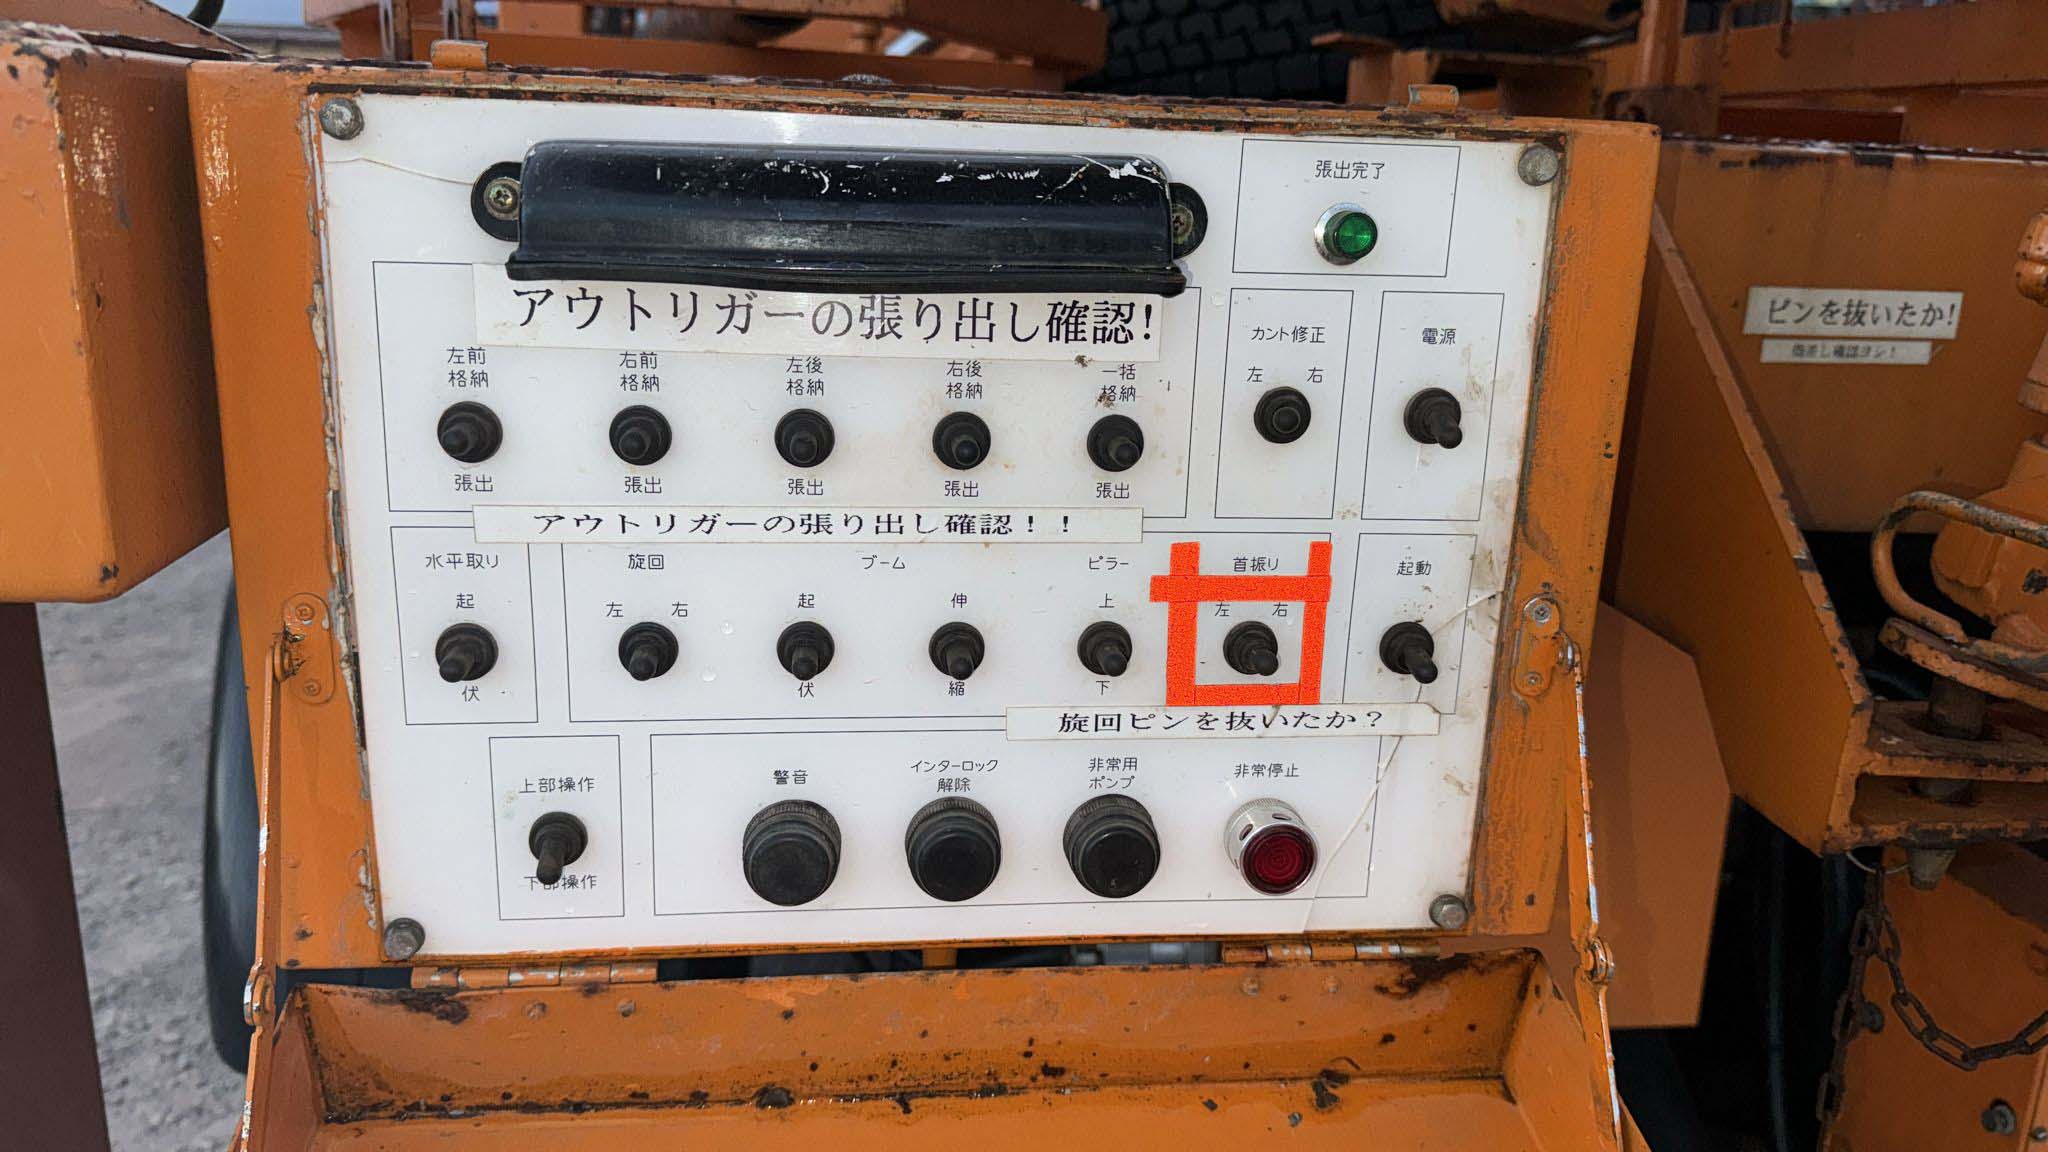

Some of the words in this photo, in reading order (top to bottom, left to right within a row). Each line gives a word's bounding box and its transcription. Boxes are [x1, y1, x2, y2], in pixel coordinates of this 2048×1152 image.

[1315, 160, 1385, 180] 張出完了
[512, 286, 1154, 346] アウトリガーの張り出し確認!
[1769, 298, 1955, 327] ピンを抜いたか!
[1251, 325, 1325, 343] カント修正
[1422, 328, 1456, 345] 電源
[446, 345, 486, 365] 左前
[619, 350, 660, 371] 右前
[785, 354, 825, 376] 左後
[946, 359, 984, 378] 右後
[1101, 363, 1136, 381] 一括
[448, 369, 488, 388] 格納
[620, 373, 659, 392] 格納
[1246, 366, 1263, 383] 左
[1307, 366, 1324, 383] 右
[785, 377, 824, 397] 格納
[945, 382, 983, 400] 格納
[1101, 383, 1137, 403] 格納
[454, 474, 493, 492] 張出
[624, 473, 662, 494] 張出
[786, 477, 826, 498] 張出
[944, 480, 979, 497] 張出
[1096, 482, 1130, 499] 張出
[425, 553, 498, 570] 水平取り
[628, 552, 664, 570] 旋回
[861, 554, 905, 570] ブーム
[1089, 555, 1128, 570] ピラー
[1233, 556, 1279, 572] 首振り
[1396, 560, 1432, 576] 起動
[456, 593, 475, 609] 起
[797, 593, 815, 608] 起
[951, 592, 967, 608] 伸
[1098, 593, 1115, 608] 上
[606, 601, 624, 618] 左
[672, 601, 688, 617] 右
[1213, 601, 1231, 618] 左
[1271, 601, 1289, 618] 右
[462, 685, 480, 702] 伏
[796, 680, 816, 699] 伏
[947, 680, 966, 697] 縮
[1096, 680, 1110, 696] 下
[1056, 710, 1384, 734] 旋回ピンを抜いたか？
[910, 760, 998, 773] インターロック
[1088, 757, 1138, 773] 非常用
[1234, 763, 1299, 778] 非常停止
[518, 776, 595, 793] 上部操作
[773, 769, 808, 785] 警音
[937, 777, 971, 792] 解除
[1089, 775, 1135, 790] ポンプ
